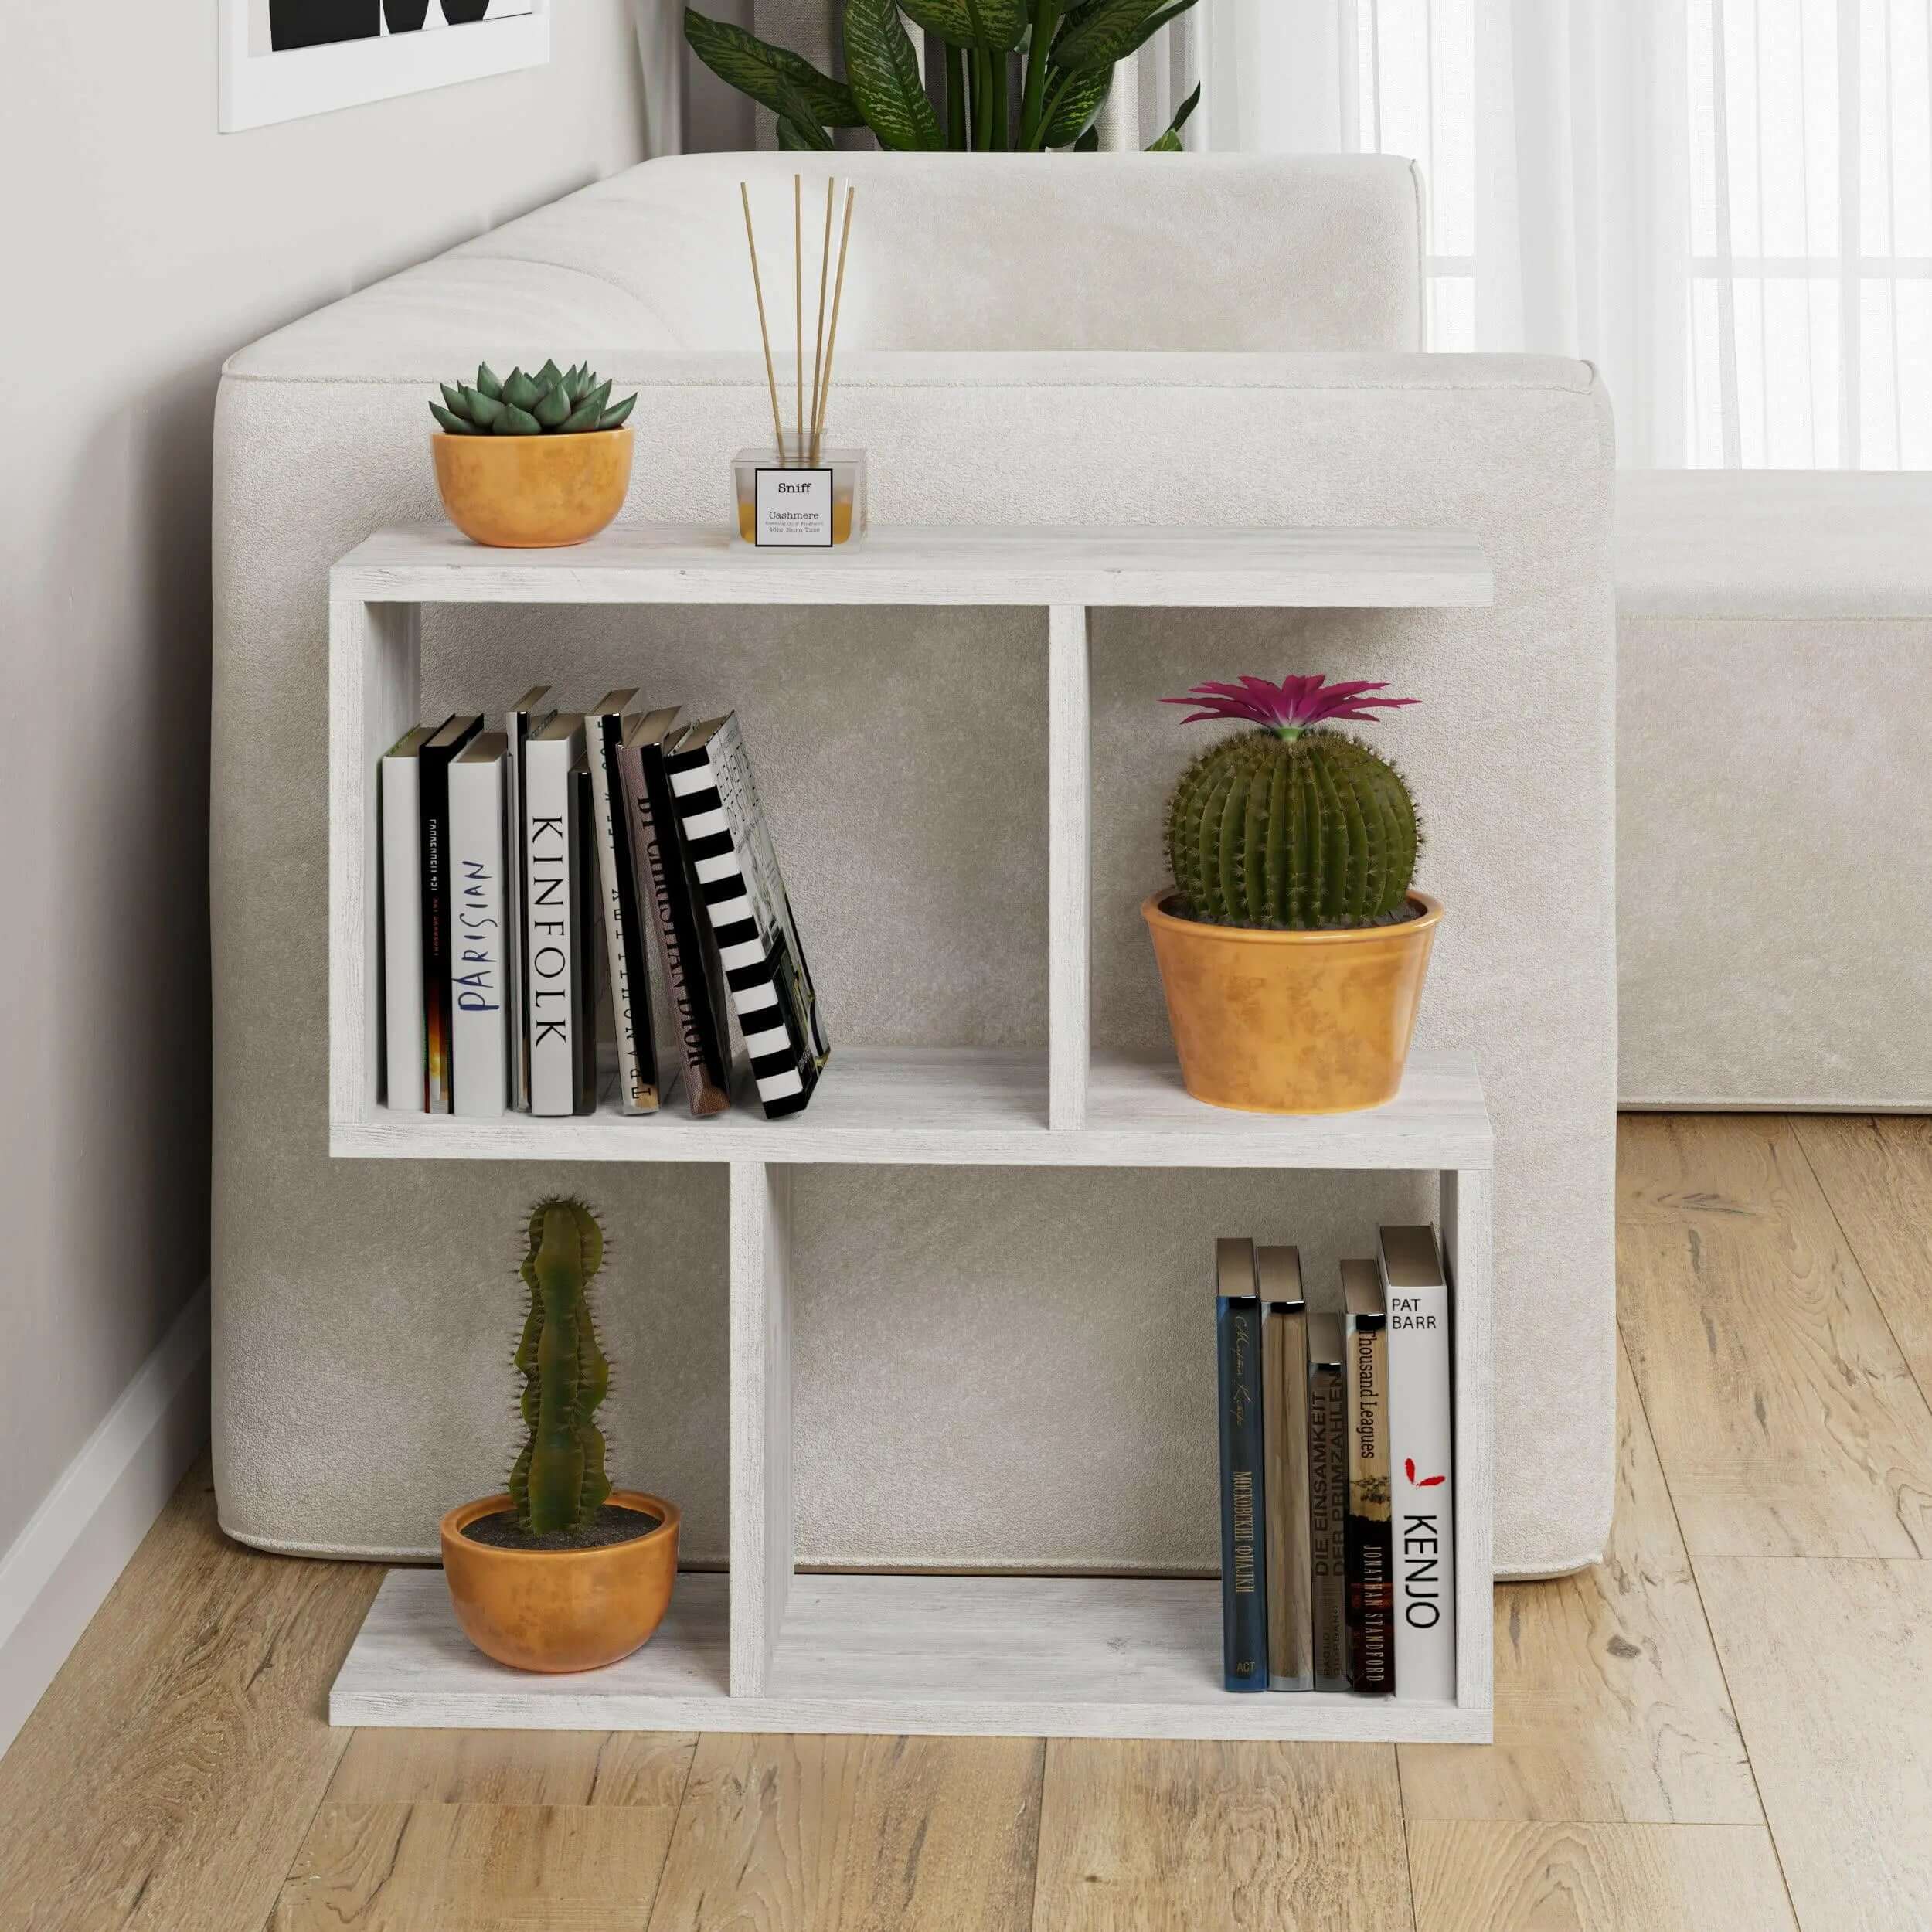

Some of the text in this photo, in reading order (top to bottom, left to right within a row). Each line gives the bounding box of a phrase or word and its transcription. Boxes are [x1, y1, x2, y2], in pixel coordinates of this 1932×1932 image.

[769, 510, 819, 519] Cashmere
[778, 482, 812, 493] Sniff
[451, 860, 500, 1011] PARISIAN
[532, 816, 566, 1048] KINFOLK
[1392, 1298, 1422, 1311] PAT
[1392, 1316, 1437, 1329] BARR
[1356, 1329, 1379, 1459] Thousand Leagues
[1233, 1471, 1255, 1593] МОСКОВСКИЕ ФИАЛКИ
[1311, 1393, 1329, 1577] DIE EINSAMKEIT
[1363, 1546, 1384, 1682] JONATHAN STANDFORD
[1404, 1515, 1440, 1629] KENJO
